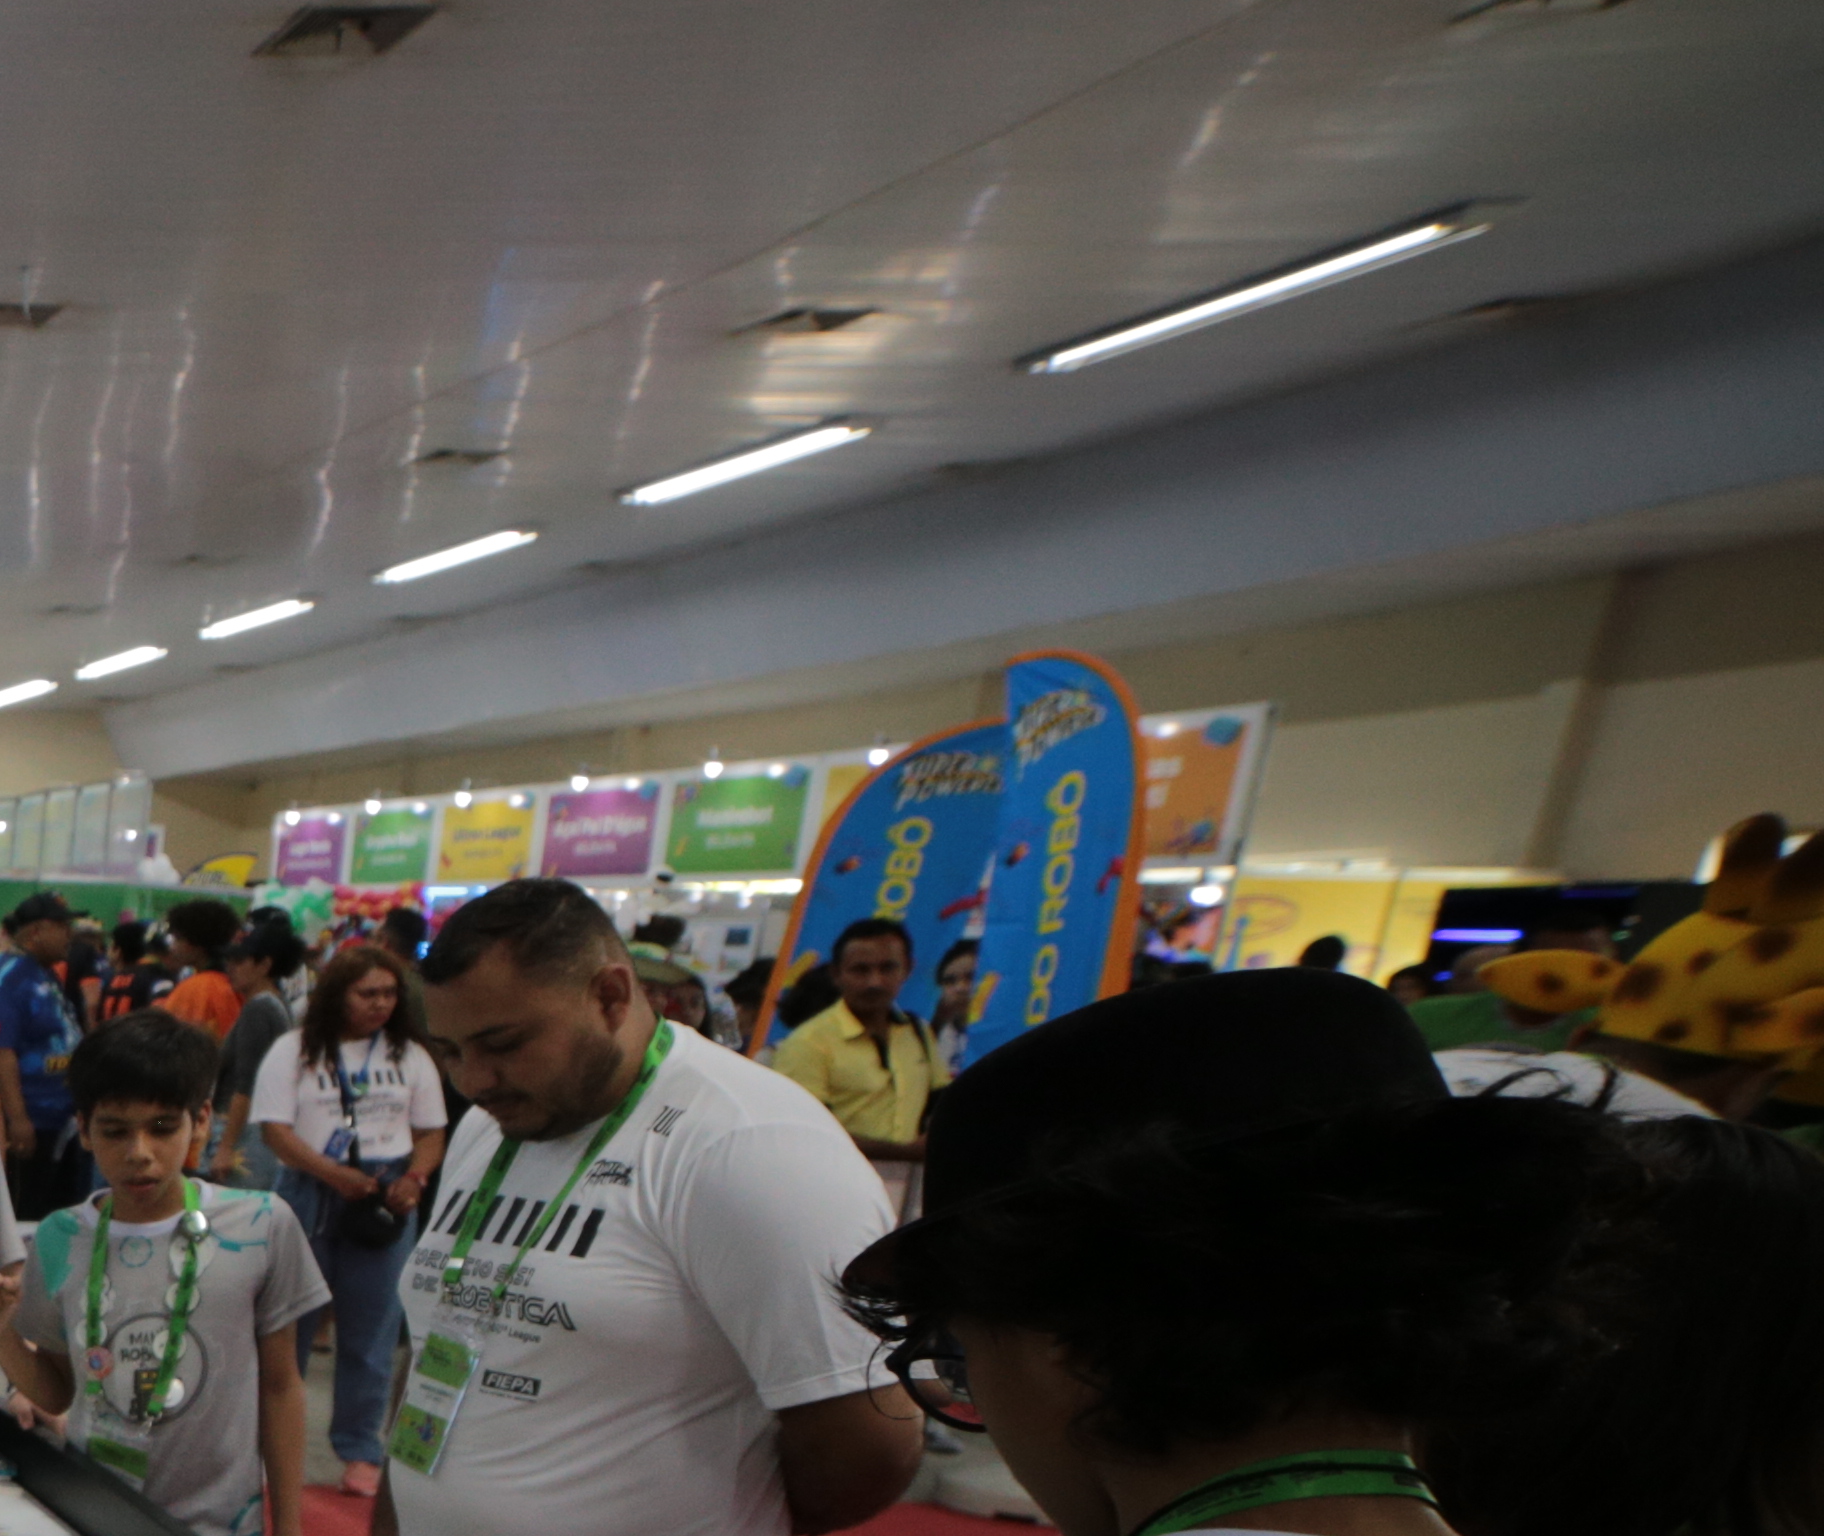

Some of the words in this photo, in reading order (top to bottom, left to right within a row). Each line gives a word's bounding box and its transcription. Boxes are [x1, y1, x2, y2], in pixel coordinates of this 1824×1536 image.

[1038, 770, 1087, 935] ROBÔ
[1025, 943, 1059, 1026] DO
[484, 1372, 539, 1395] FIEPA
